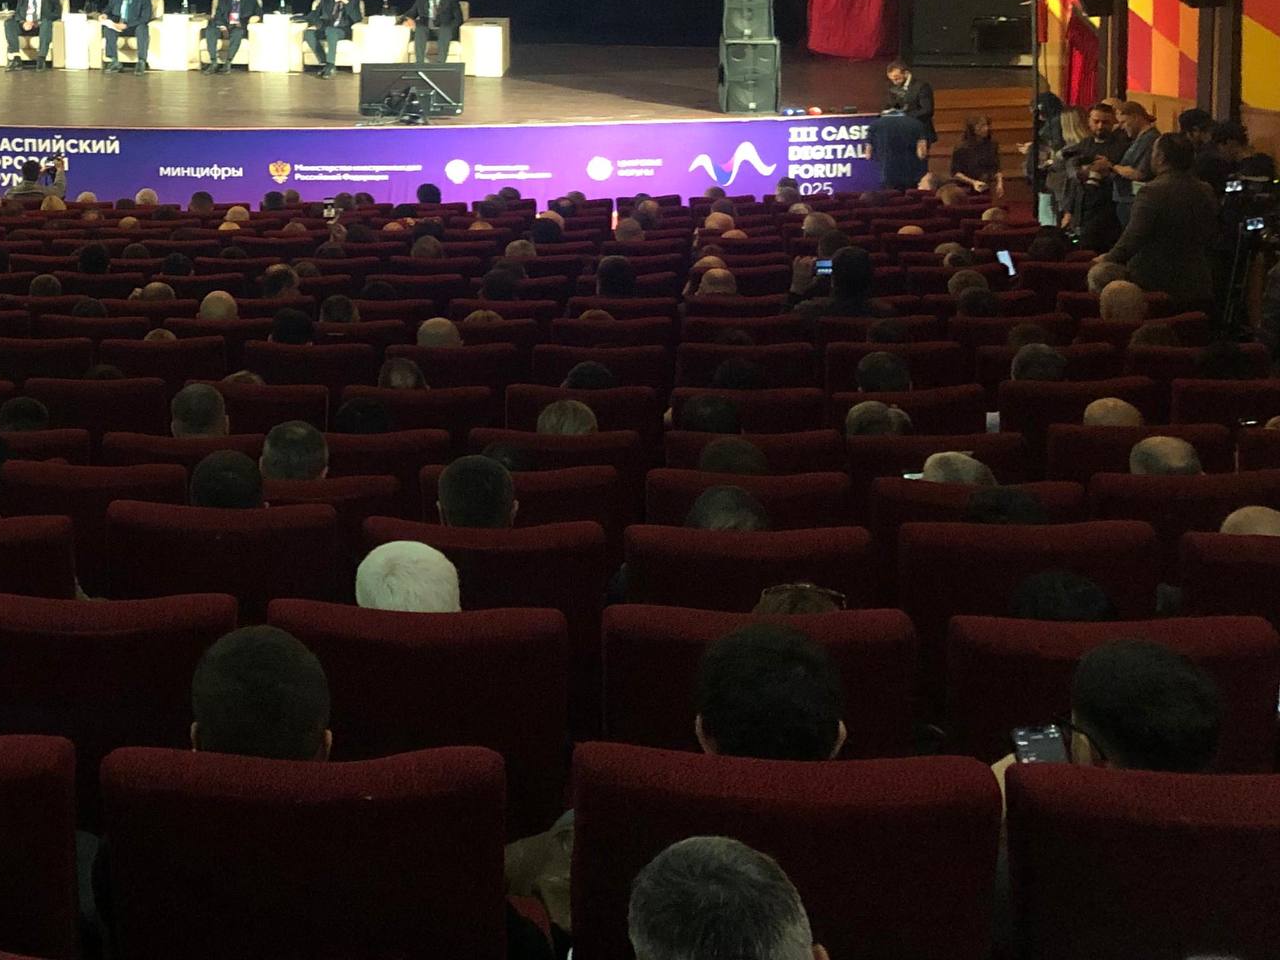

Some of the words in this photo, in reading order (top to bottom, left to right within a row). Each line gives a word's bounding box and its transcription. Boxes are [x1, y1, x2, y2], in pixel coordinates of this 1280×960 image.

[787, 144, 869, 161] DIGITAL
[159, 164, 244, 181] минцифры
[787, 163, 852, 179] FORUM
